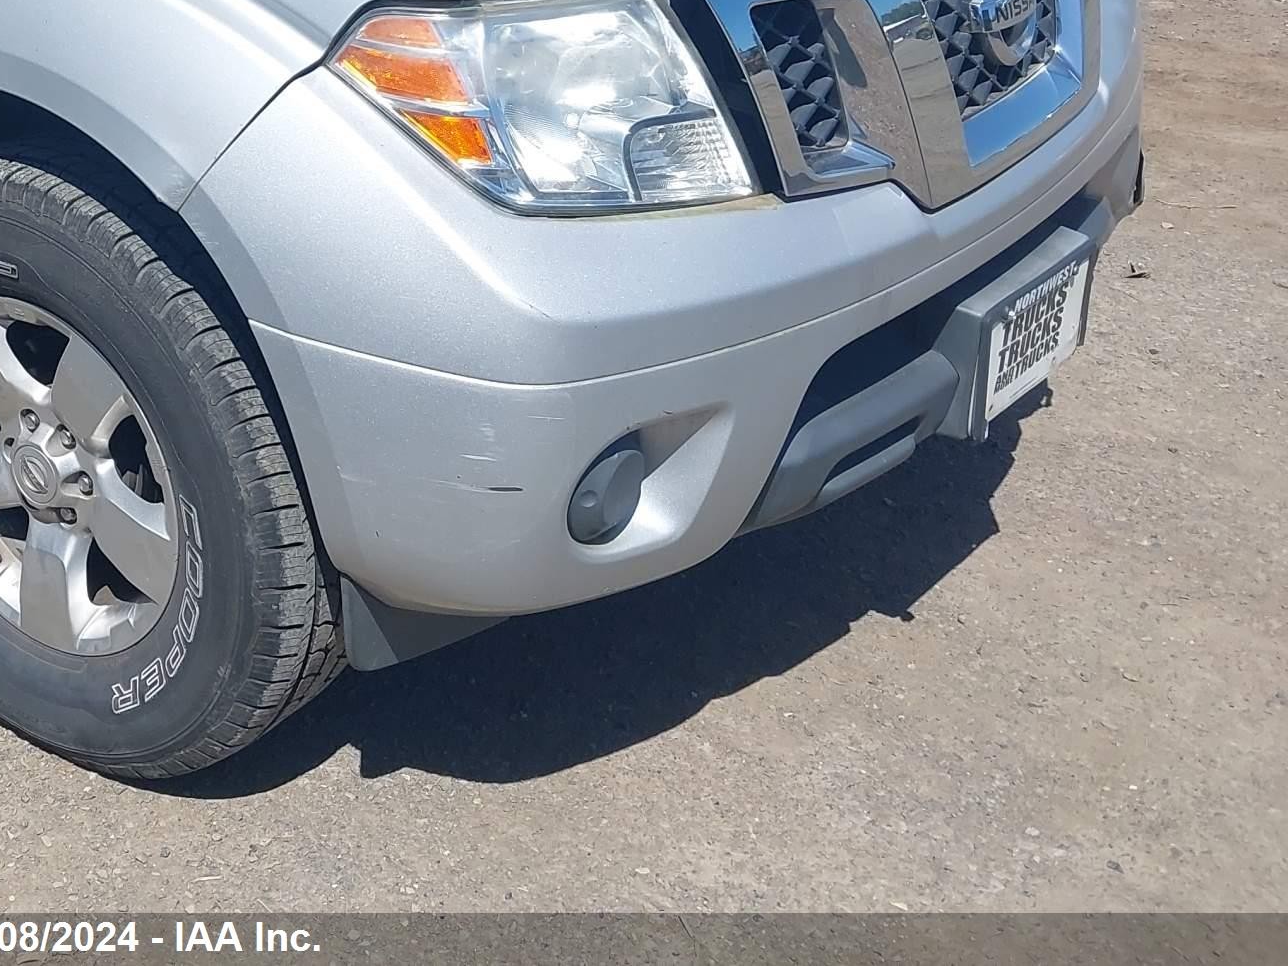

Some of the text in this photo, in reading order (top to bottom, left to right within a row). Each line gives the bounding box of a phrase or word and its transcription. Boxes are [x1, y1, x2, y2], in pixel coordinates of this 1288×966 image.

[1002, 281, 1070, 348] TRUCKS
[1014, 260, 1077, 313] NORTHWEST
[998, 307, 1064, 374] TRUCKS
[1013, 332, 1059, 380] TRUCKS
[111, 494, 203, 714] COOPER
